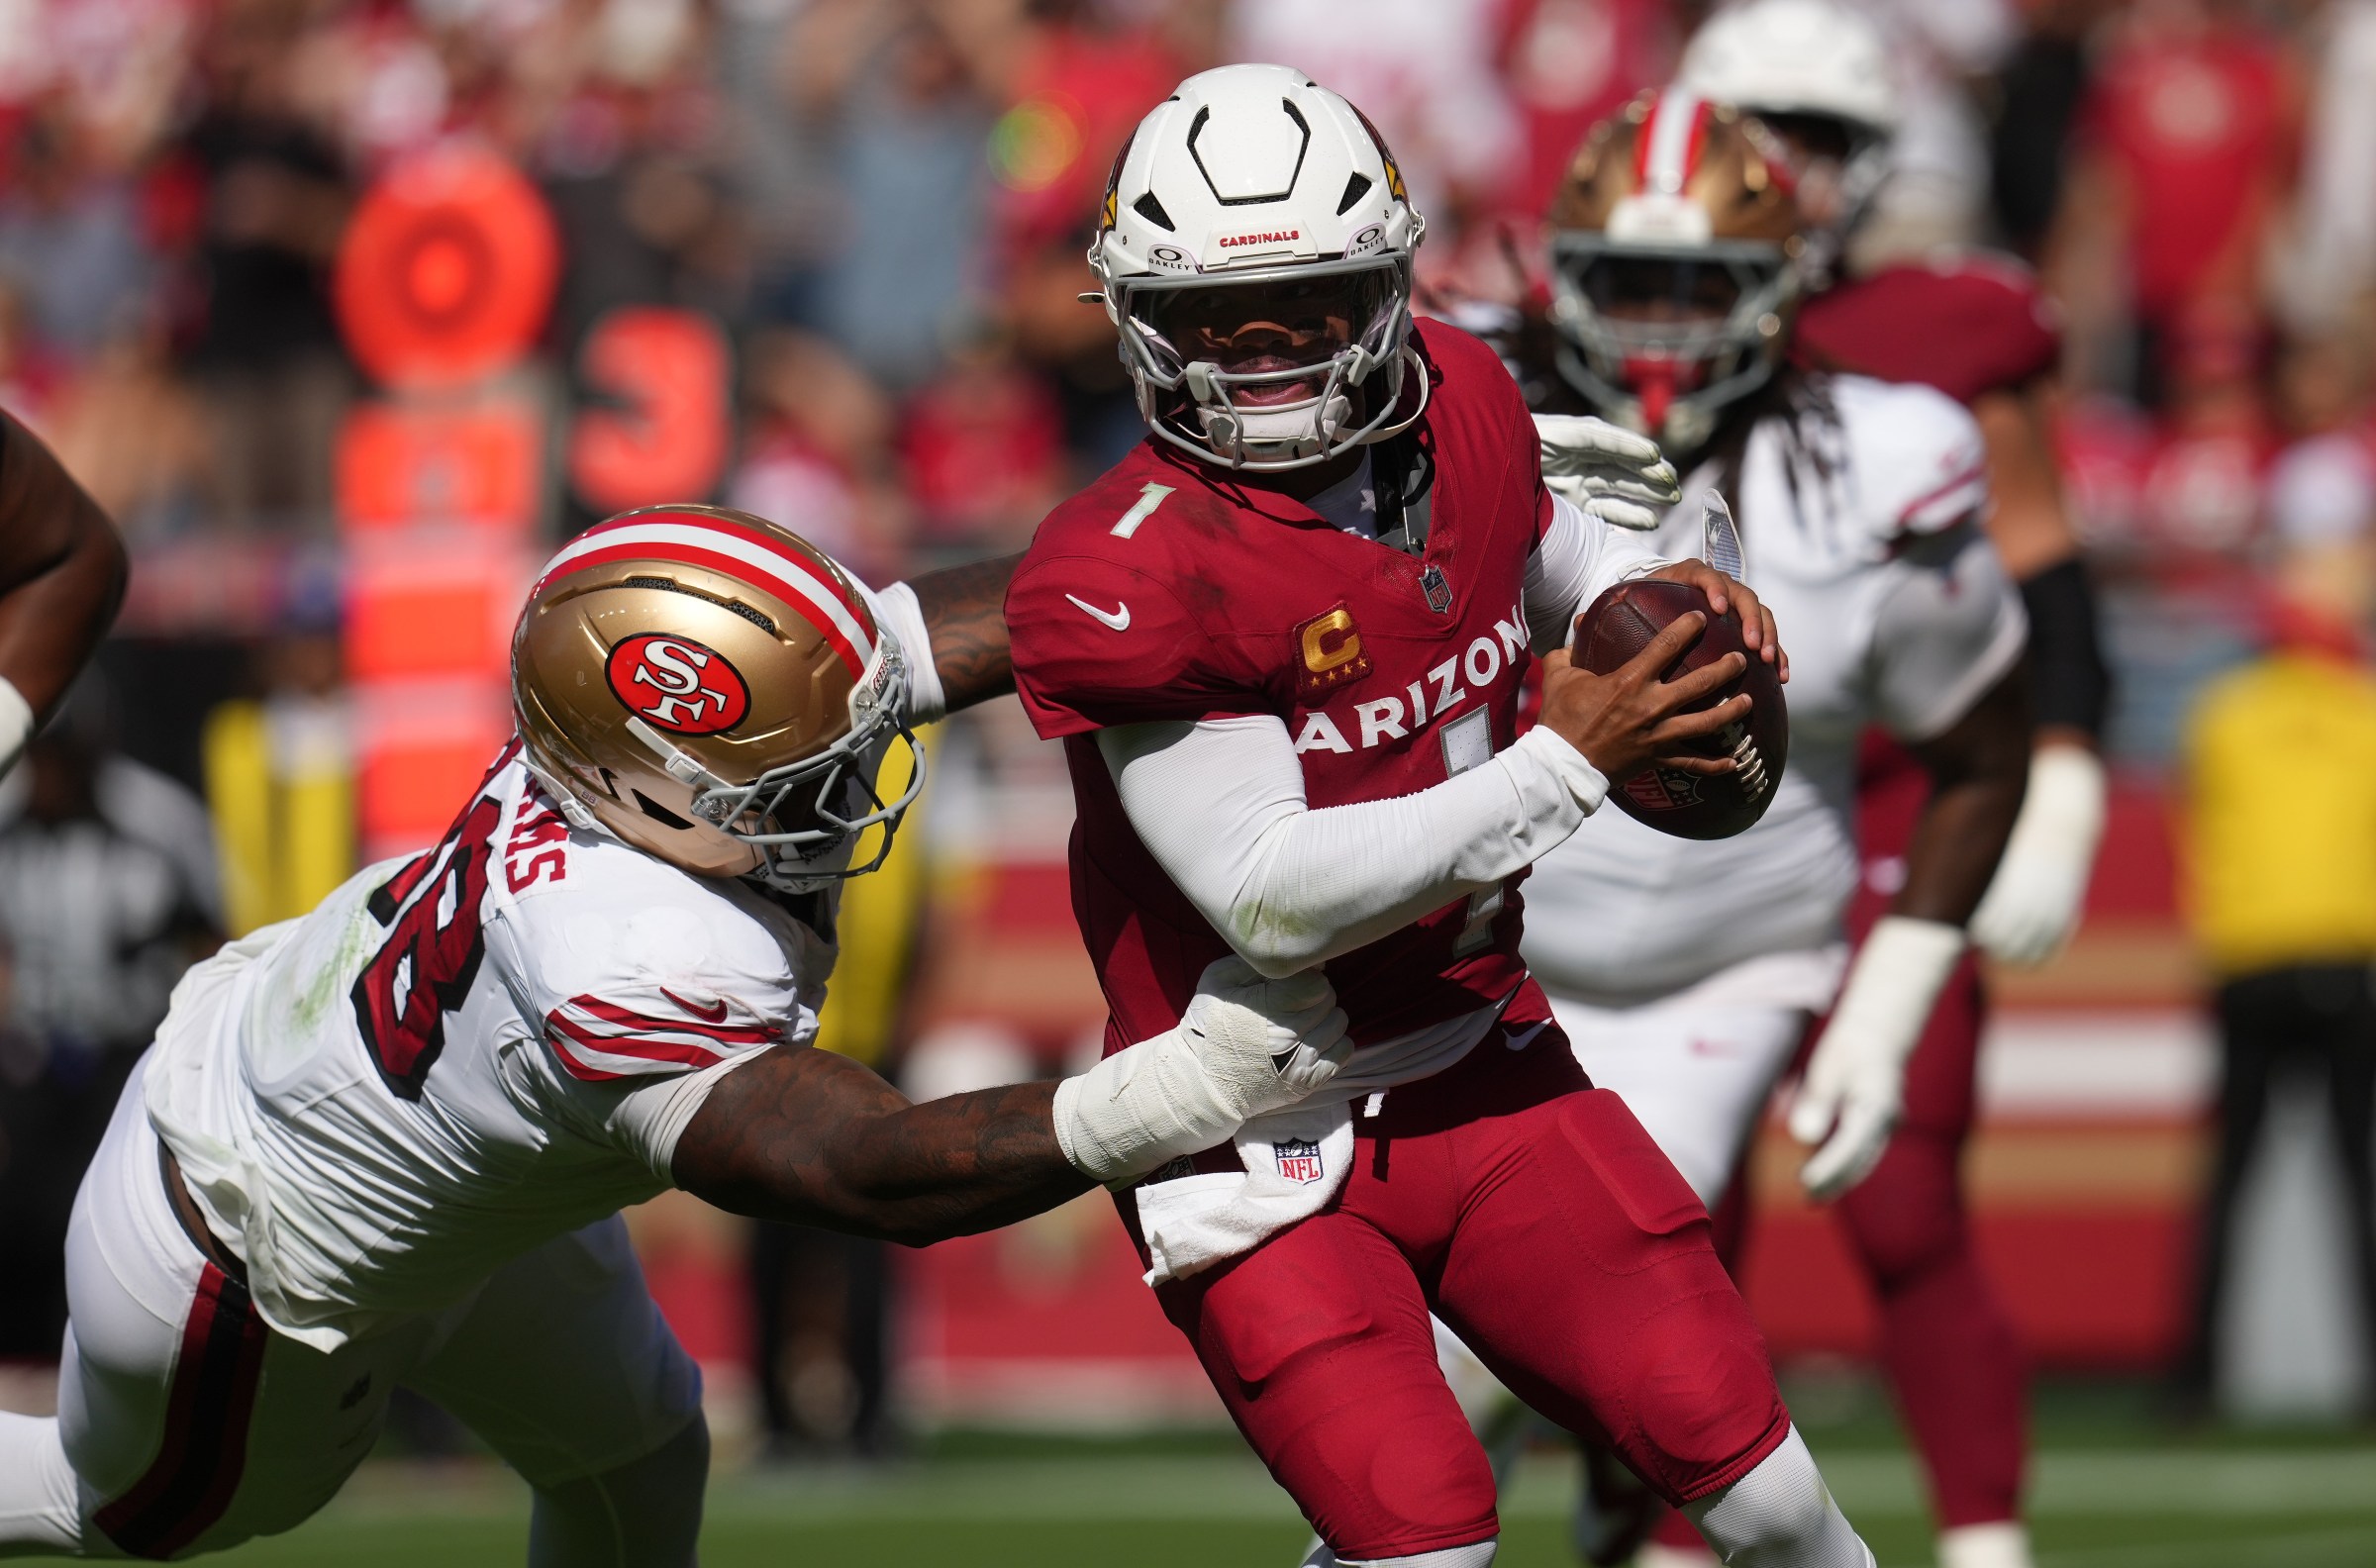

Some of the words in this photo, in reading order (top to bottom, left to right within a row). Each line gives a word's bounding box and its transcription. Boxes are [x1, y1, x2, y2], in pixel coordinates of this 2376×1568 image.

[1220, 230, 1299, 247] CARDINALS
[1350, 235, 1385, 256] OAKLEY
[1148, 257, 1190, 271] OAKLEY
[1110, 480, 1177, 539] 1
[1302, 609, 1361, 673] C
[633, 638, 729, 727] SF
[1280, 1157, 1320, 1181] NFL
